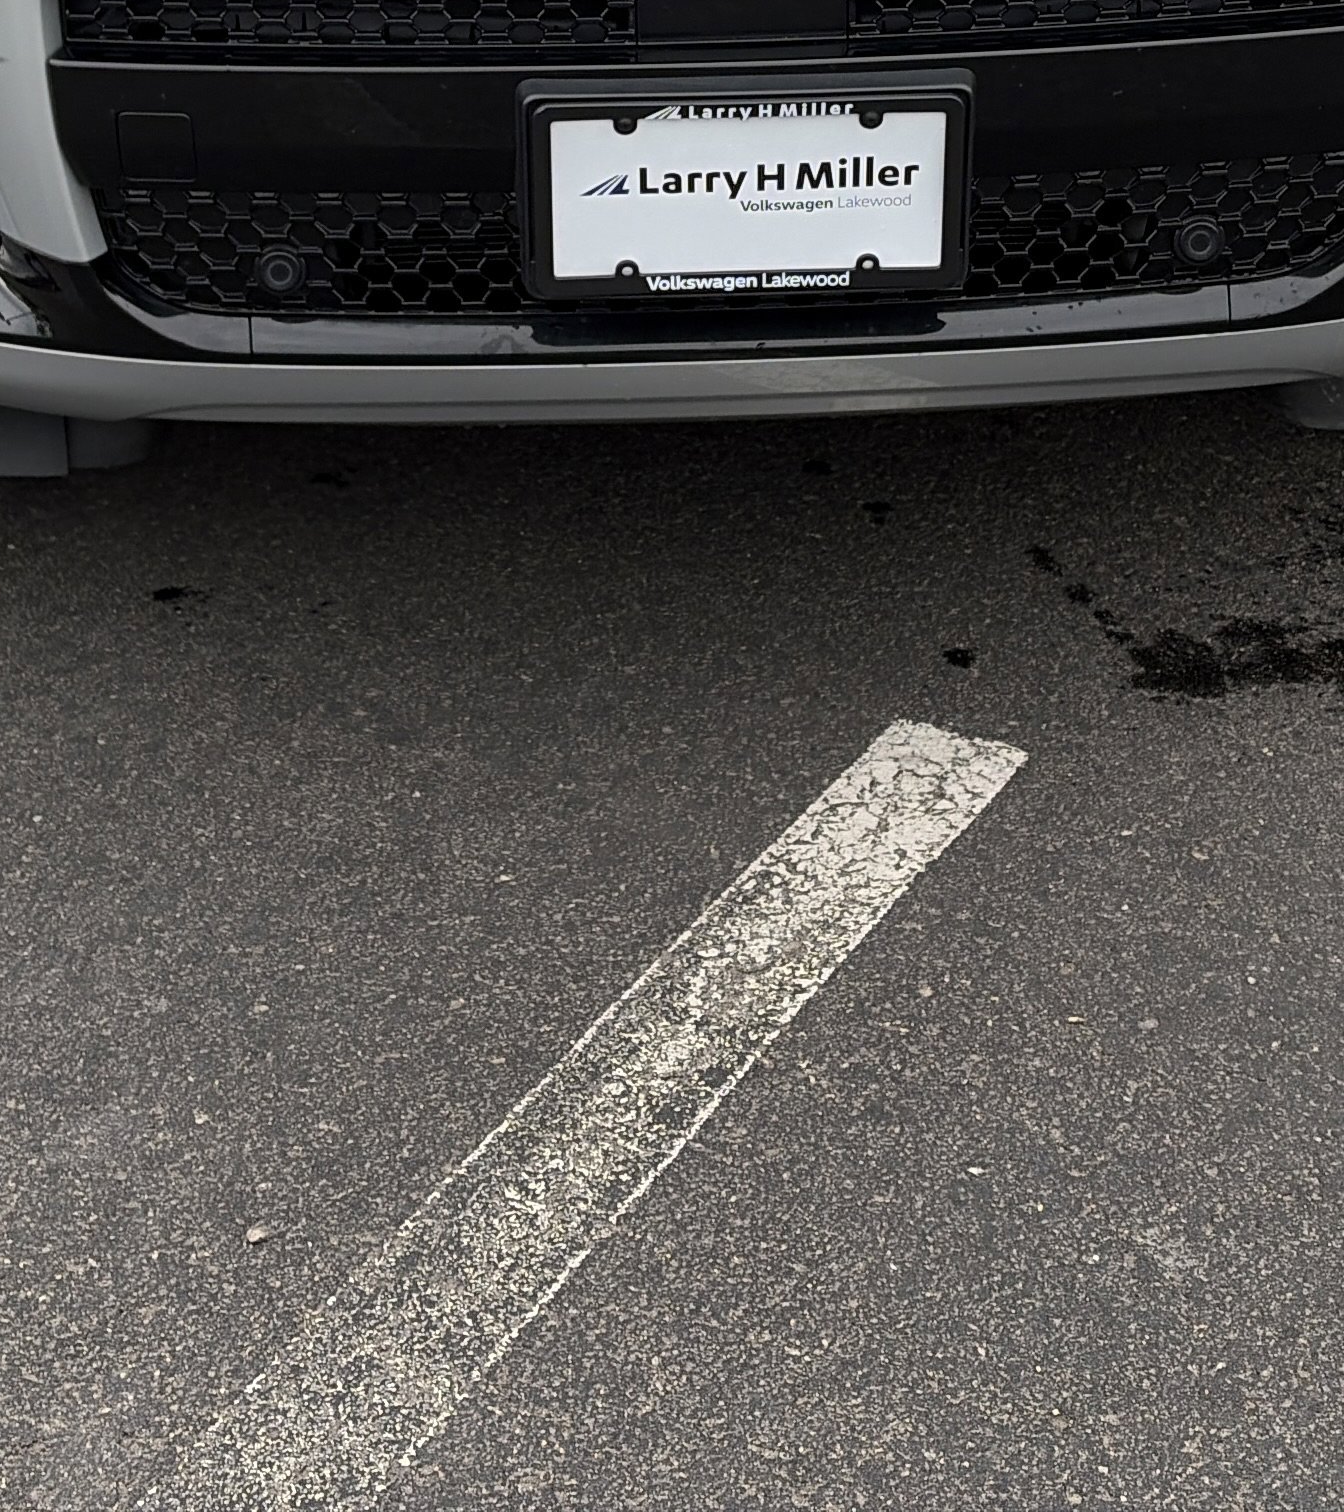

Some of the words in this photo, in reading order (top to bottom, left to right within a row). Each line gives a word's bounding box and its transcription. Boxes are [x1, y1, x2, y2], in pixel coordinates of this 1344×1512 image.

[688, 105, 752, 121] Larry
[758, 104, 772, 118] H
[779, 102, 854, 117] Miller
[639, 168, 747, 199] Larry
[757, 163, 785, 191] H
[795, 156, 919, 189] Miller
[740, 198, 833, 212] Volkswagen
[837, 194, 912, 209] Lakewood
[646, 275, 757, 291] Volkswagen
[762, 271, 850, 288] Lakewood
